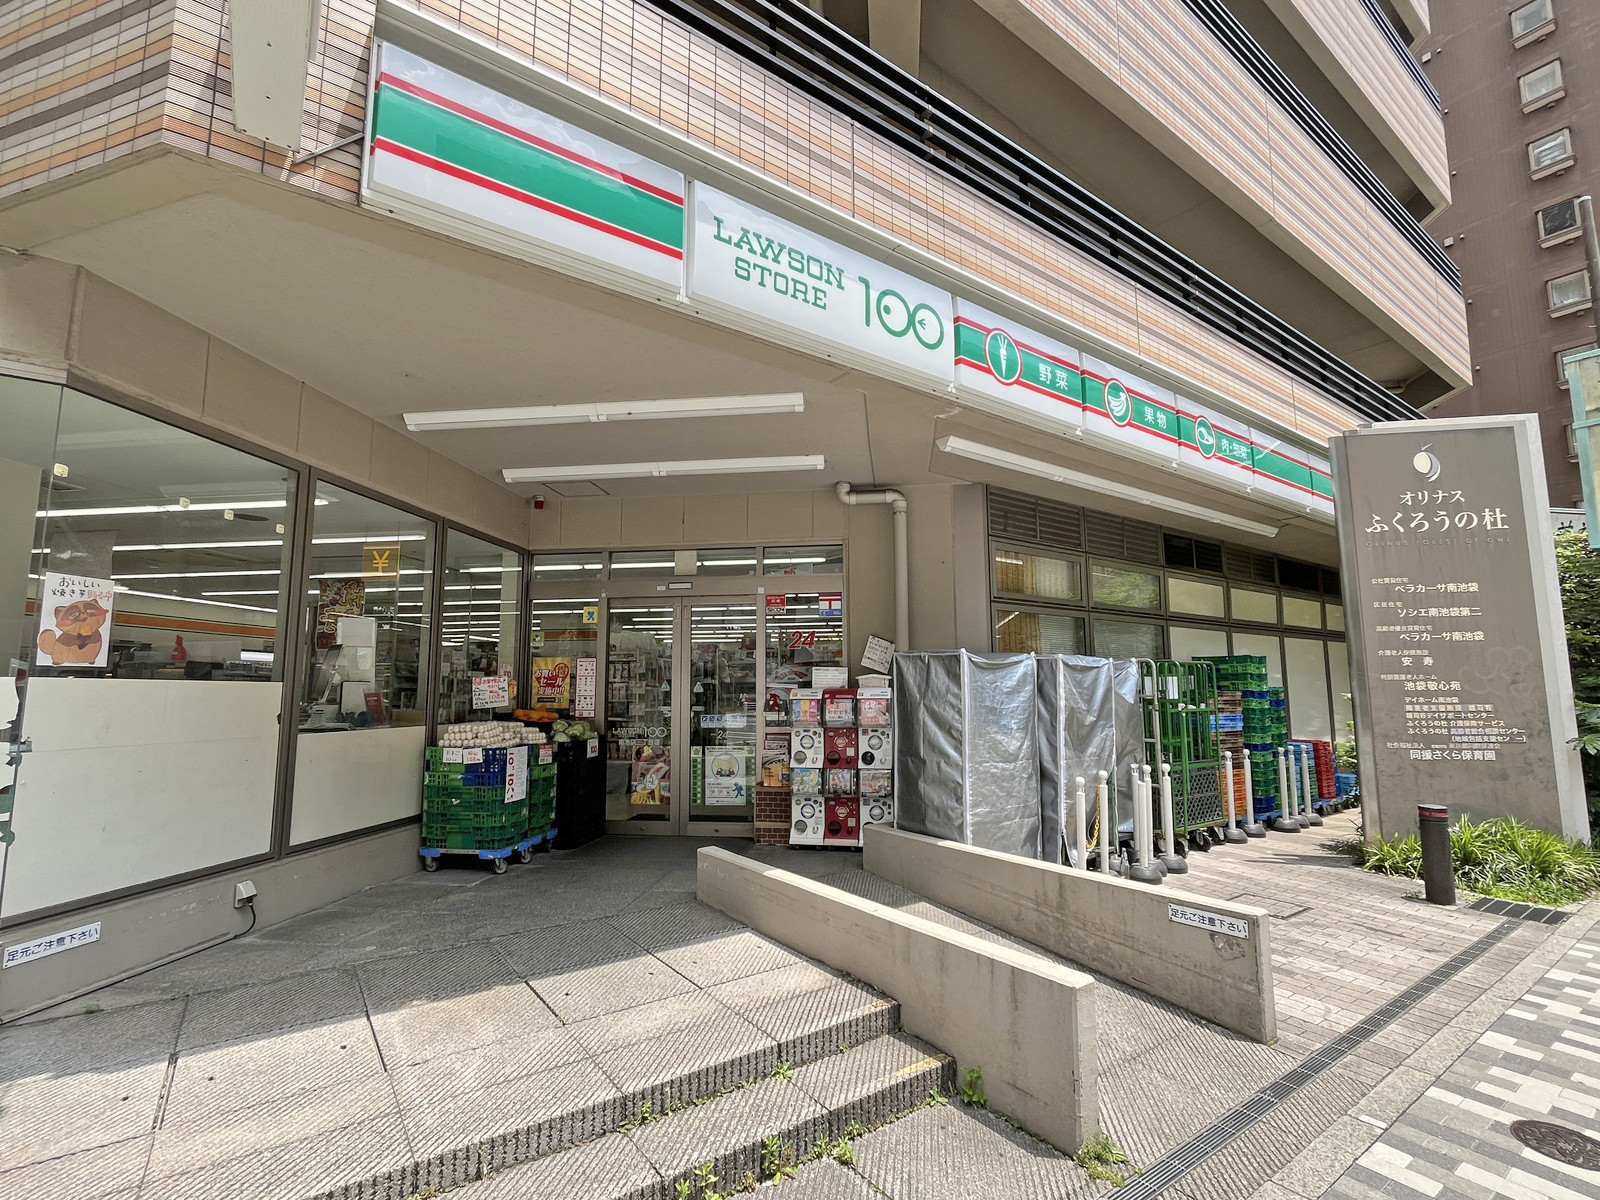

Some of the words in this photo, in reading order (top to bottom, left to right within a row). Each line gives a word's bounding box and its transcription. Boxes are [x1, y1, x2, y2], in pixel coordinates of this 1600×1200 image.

[713, 215, 845, 291] LAWSON
[734, 256, 828, 311] STORE
[858, 275, 945, 350] 100
[1038, 362, 1070, 391] 野菜
[1144, 405, 1168, 430] 果物
[1399, 489, 1466, 506] オリナス
[1364, 507, 1510, 534] ふくろうの杜
[58, 576, 101, 588] おいしい
[1394, 582, 1479, 592] ベラカーサ南池袋
[1397, 607, 1481, 617] ソシエ南池袋第二
[788, 630, 816, 650] 24
[1399, 631, 1484, 641] ベラカーサ南池袋
[539, 677, 564, 686] セール
[1403, 680, 1461, 690] 池袋敬心苑
[644, 726, 667, 738] 100
[1409, 749, 1496, 760] 同援さくら保育園
[1170, 907, 1248, 934] 足元ご注意下さい
[5, 927, 99, 964] 足元ご注意下さい
